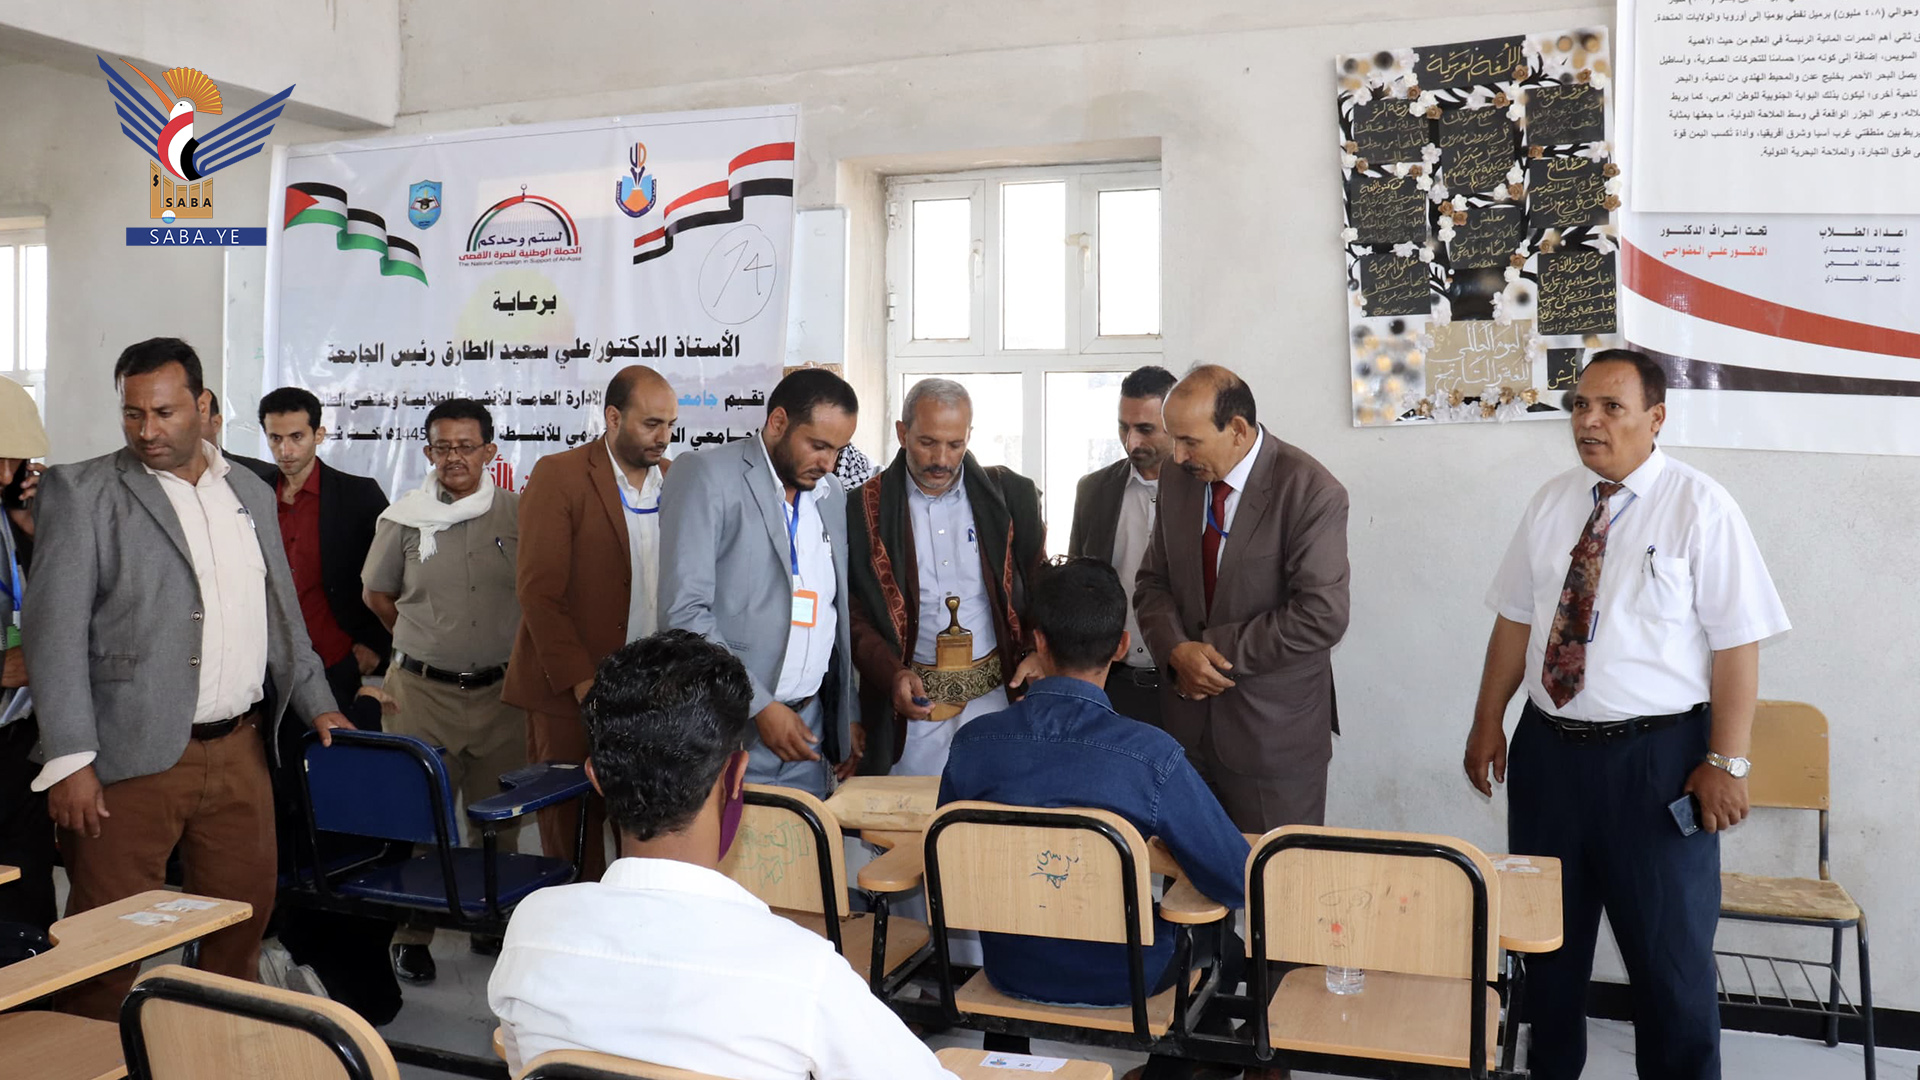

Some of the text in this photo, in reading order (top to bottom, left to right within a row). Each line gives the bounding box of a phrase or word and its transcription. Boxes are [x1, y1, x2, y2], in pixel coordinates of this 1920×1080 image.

[1686, 12, 1720, 22] والولايات
[1786, 10, 1806, 20] نفطي
[1809, 10, 1831, 19] برميل
[1888, 7, 1919, 18] وحوالي
[1688, 35, 1714, 46] الأهمية
[1717, 36, 1733, 45] حيث
[1750, 35, 1769, 46] العالم
[1772, 35, 1782, 46] في
[1785, 34, 1814, 45] الرئيسة
[1817, 34, 1841, 44] المائية
[1844, 33, 1876, 43] الممرات
[1878, 31, 1892, 43] أهم
[1894, 31, 1912, 43] ثاني
[1733, 53, 1767, 65] للتحركات
[1675, 74, 1699, 84] والبحر
[1727, 75, 1739, 83] من
[1741, 72, 1767, 83] الهندي
[1768, 72, 1800, 82] والمحيط
[1802, 73, 1819, 82] عدن
[1822, 72, 1845, 83] بخليج
[1848, 70, 1873, 82] الأحمر
[1876, 71, 1896, 81] البحر
[1898, 70, 1918, 80] يصل
[1671, 92, 1689, 102] يربط
[1691, 92, 1704, 100] كما
[1736, 91, 1760, 101] للوطن
[1761, 90, 1793, 101] الجنوبية
[1794, 90, 1820, 101] البوابة
[1822, 90, 1840, 100] بذلك
[1842, 90, 1865, 101] ليكون
[1896, 88, 1918, 98] ناحية
[1669, 110, 1690, 120] بمثابة
[1693, 110, 1714, 121] جعلها
[1757, 109, 1785, 119] الملاحة
[1786, 110, 1807, 120] وسط
[1809, 109, 1820, 121] في
[1822, 109, 1849, 119] الواقعة
[1853, 109, 1875, 120] الجزر
[1878, 110, 1899, 119] وعبر
[1900, 109, 1920, 118] لاله،
[1673, 129, 1687, 139] قوة
[1689, 129, 1709, 139] اليمن
[1786, 128, 1812, 139] وشرق
[1833, 128, 1851, 138] غرب
[1855, 128, 1884, 140] منطقتي
[1887, 130, 1901, 138] بين
[1791, 146, 1819, 157] البحرية
[1821, 146, 1855, 157] والملاحة
[1891, 146, 1911, 157] طرق
[1660, 224, 1705, 238] الدكتور
[1745, 225, 1768, 236] تحت
[1819, 225, 1908, 240] اعداد الطلاب
[477, 231, 562, 249] لستم وحدكم
[458, 246, 582, 262] الحملة الوطنية لنصرة الأقصى
[1707, 245, 1728, 260] علي
[1730, 245, 1768, 258] الدكتور
[471, 259, 493, 267] National
[494, 258, 522, 267] Campaign
[529, 256, 552, 265] Support
[493, 289, 557, 317] برعاية
[674, 329, 741, 359] الأستاذ
[327, 342, 384, 367] الجامعة
[391, 339, 435, 367] رئيس
[442, 339, 494, 367] الطارق
[500, 342, 549, 366] سعيد
[516, 389, 561, 407] العامة
[677, 389, 718, 410] جامع
[725, 389, 765, 412] تقيم
[347, 426, 382, 440] تحت
[499, 422, 561, 442] للأنشطة
